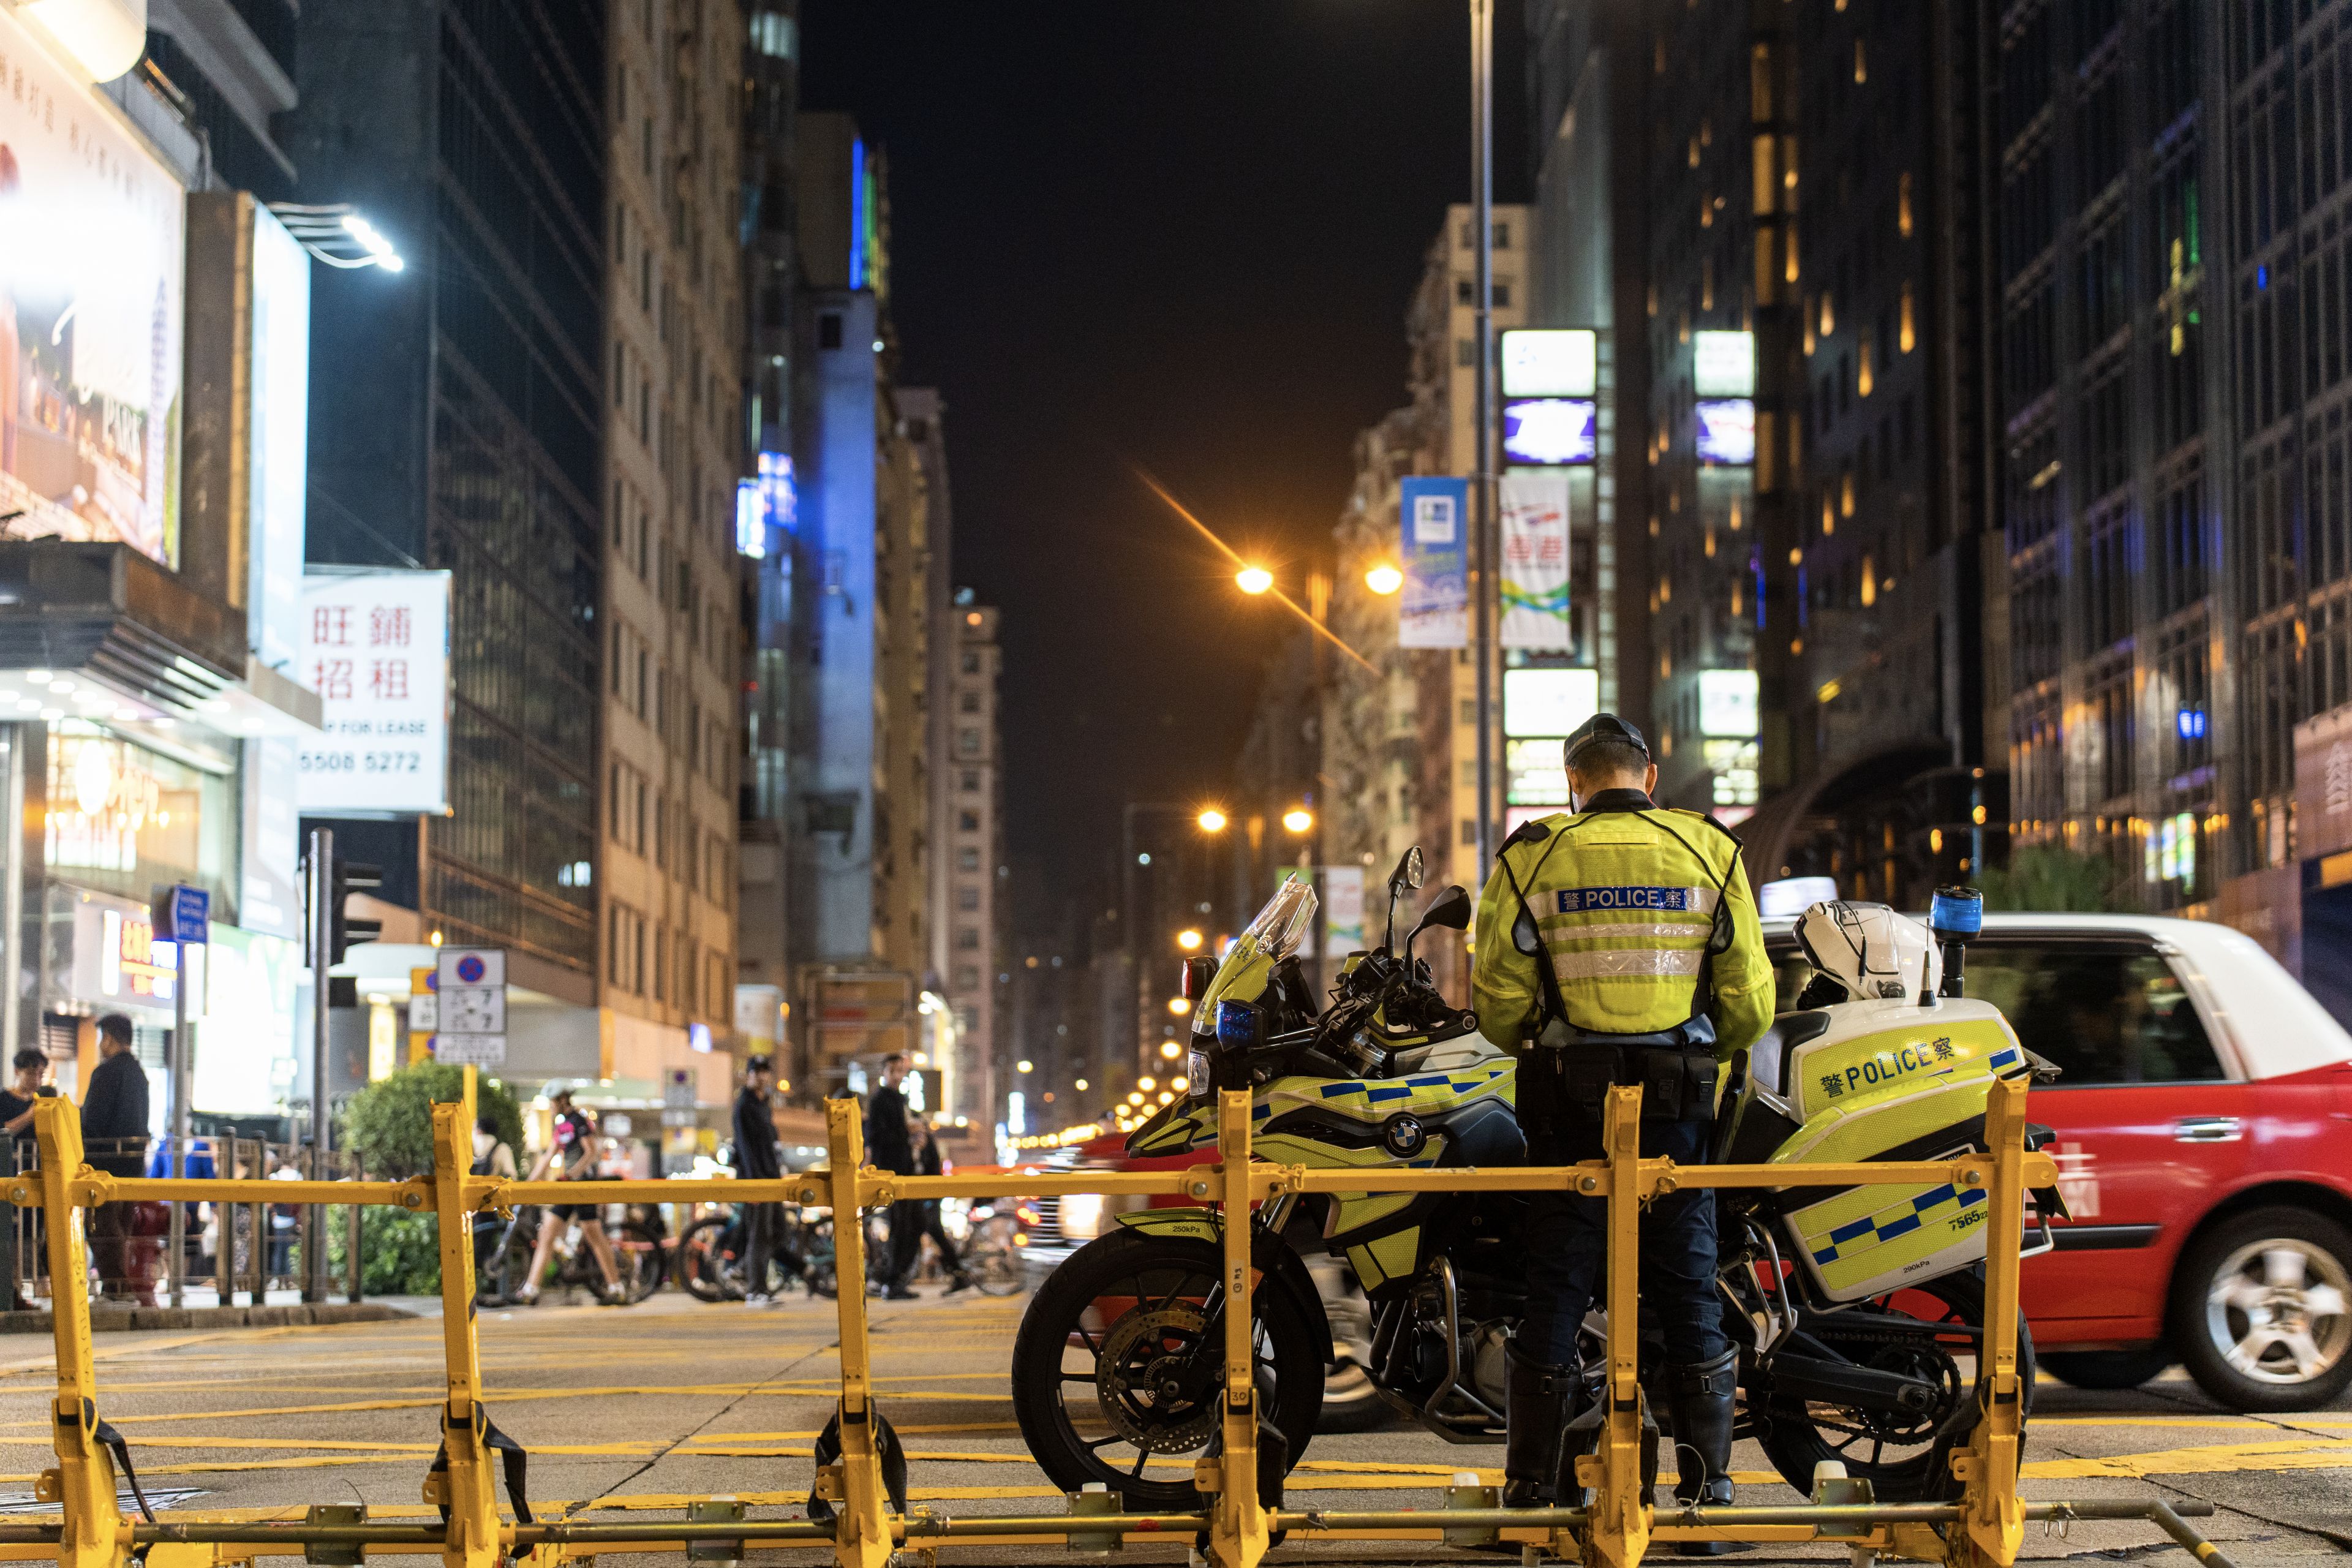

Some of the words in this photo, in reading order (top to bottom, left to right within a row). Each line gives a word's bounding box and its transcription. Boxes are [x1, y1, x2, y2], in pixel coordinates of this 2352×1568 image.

[102, 392, 141, 464] PARK
[314, 658, 409, 701] 招租
[341, 719, 372, 734] FOR
[377, 719, 426, 734] LEASE
[300, 751, 355, 772] 5508
[366, 751, 421, 772] 5272
[1564, 892, 1580, 910] 警
[1586, 889, 1659, 907] POLICE
[1665, 891, 1681, 908] 察
[1932, 1036, 1954, 1061] 察
[1845, 1042, 1933, 1091] POLICE
[1820, 1073, 1844, 1099] 警
[1948, 1210, 1980, 1231] 7565
[1902, 1259, 1930, 1275] 290kPa
[1232, 1392, 1246, 1401] 30
